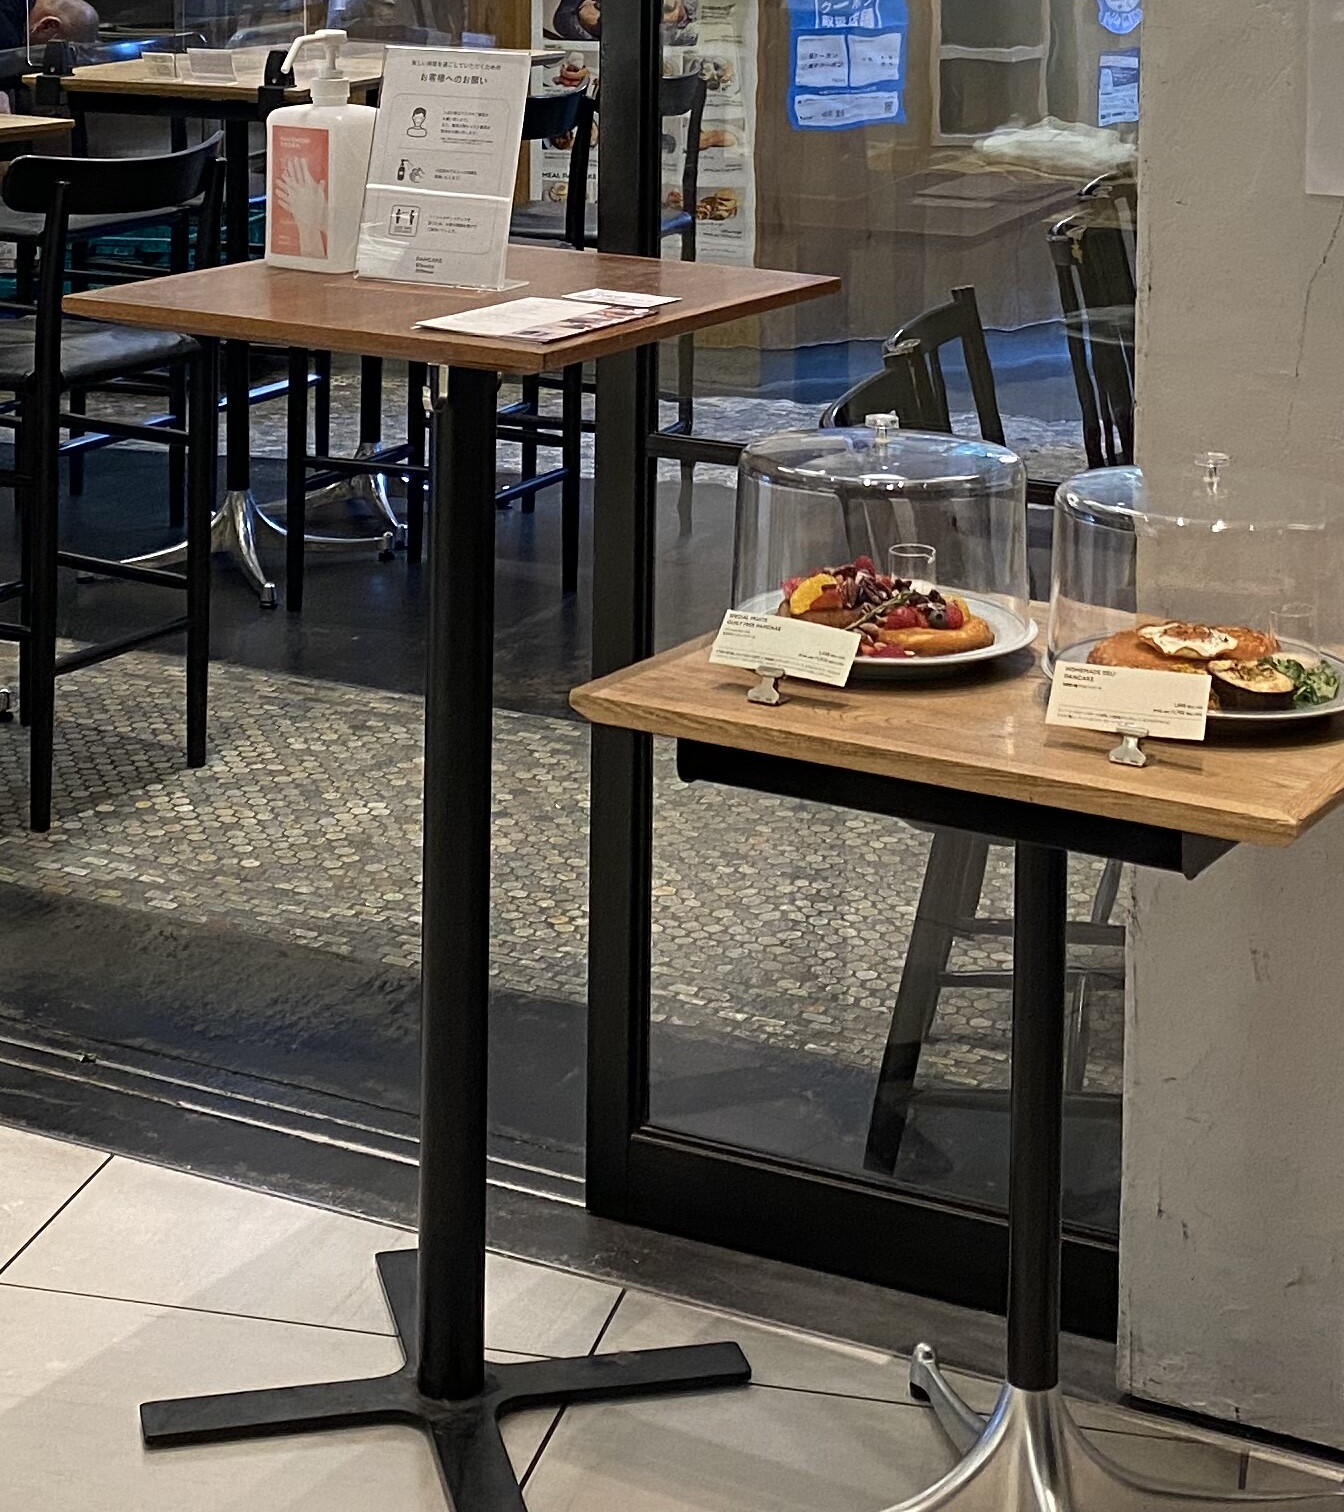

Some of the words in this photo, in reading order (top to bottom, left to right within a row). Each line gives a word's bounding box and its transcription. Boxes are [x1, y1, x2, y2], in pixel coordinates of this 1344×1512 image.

[421, 73, 488, 85] お客様へのお願い
